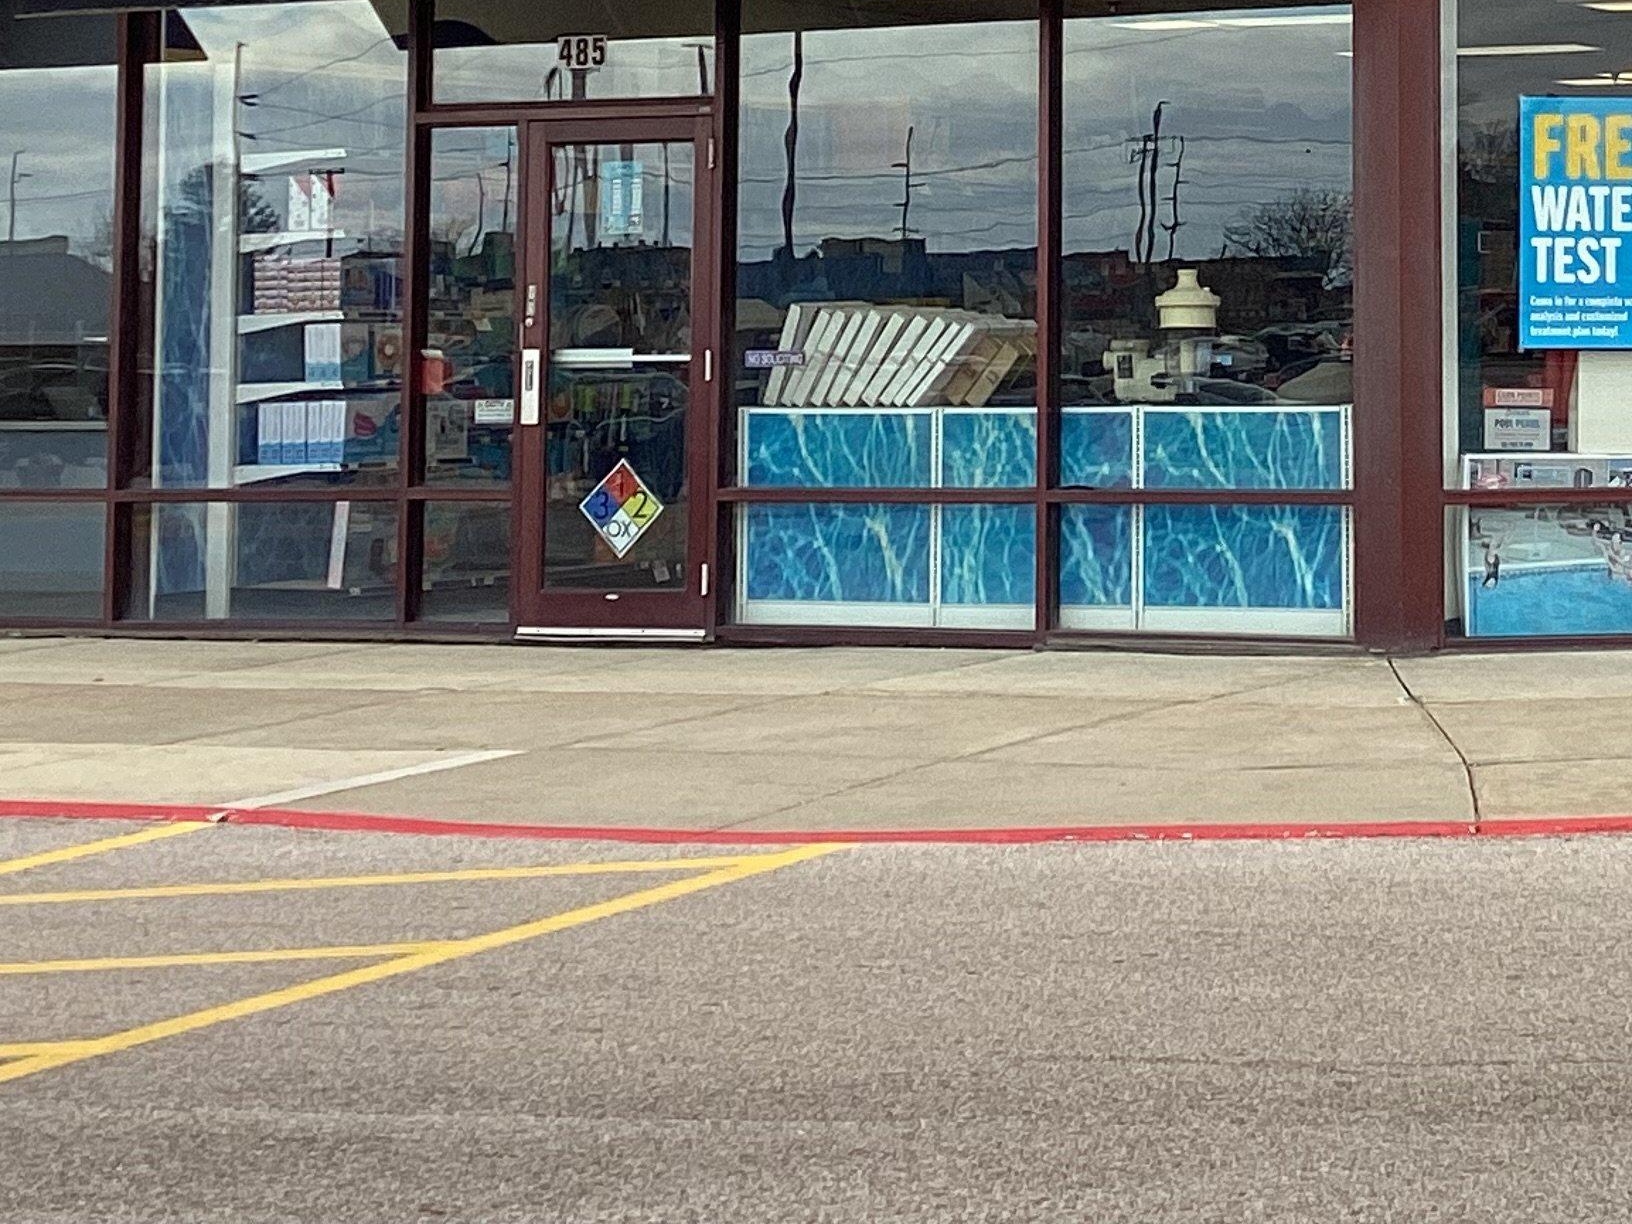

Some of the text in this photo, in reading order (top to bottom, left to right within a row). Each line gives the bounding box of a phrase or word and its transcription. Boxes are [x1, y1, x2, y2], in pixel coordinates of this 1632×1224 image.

[558, 37, 605, 67] 485
[1530, 237, 1623, 284] TEST
[593, 491, 609, 520] 3
[632, 491, 648, 518] 2
[606, 520, 632, 538] OX
